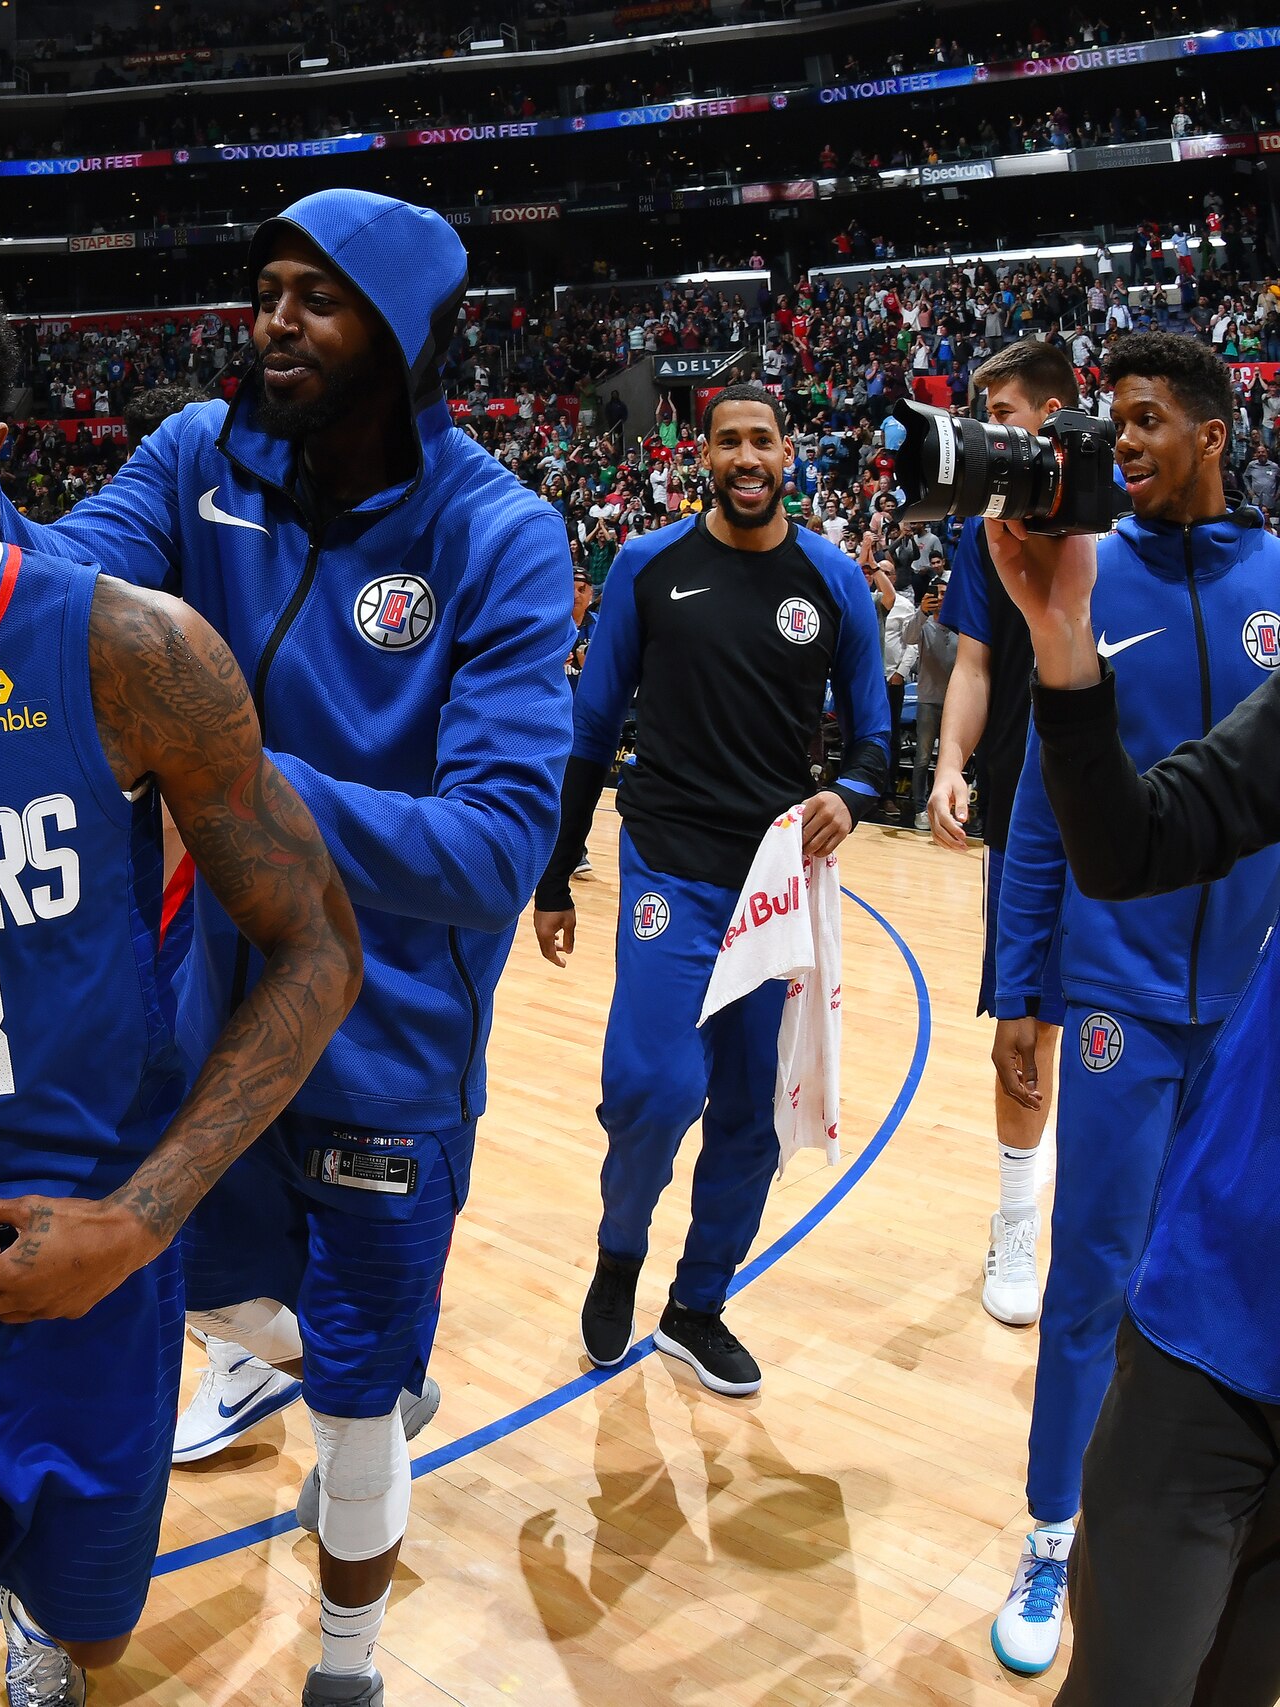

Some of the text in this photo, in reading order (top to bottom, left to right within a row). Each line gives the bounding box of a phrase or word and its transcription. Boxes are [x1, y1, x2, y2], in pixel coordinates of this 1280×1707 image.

[1233, 30, 1263, 49] ON
[1023, 45, 1146, 75] ON YOUR FEET
[820, 72, 941, 103] ON YOUR FEET
[619, 100, 737, 126] ON YOUR FEET
[419, 122, 538, 144] ON YOUR FEET
[222, 140, 341, 160] ON YOUR FEET
[26, 154, 143, 175] ON YOUR FEET
[922, 162, 988, 184] Spectrum
[638, 195, 654, 204] PHI
[638, 204, 655, 213] MIL
[709, 197, 729, 207] NBA
[492, 206, 560, 222] TOYOTA
[72, 234, 134, 251] STAPLES
[677, 359, 722, 372] DELT
[720, 875, 799, 953] ed Bull
[342, 1160, 351, 1168] 52
